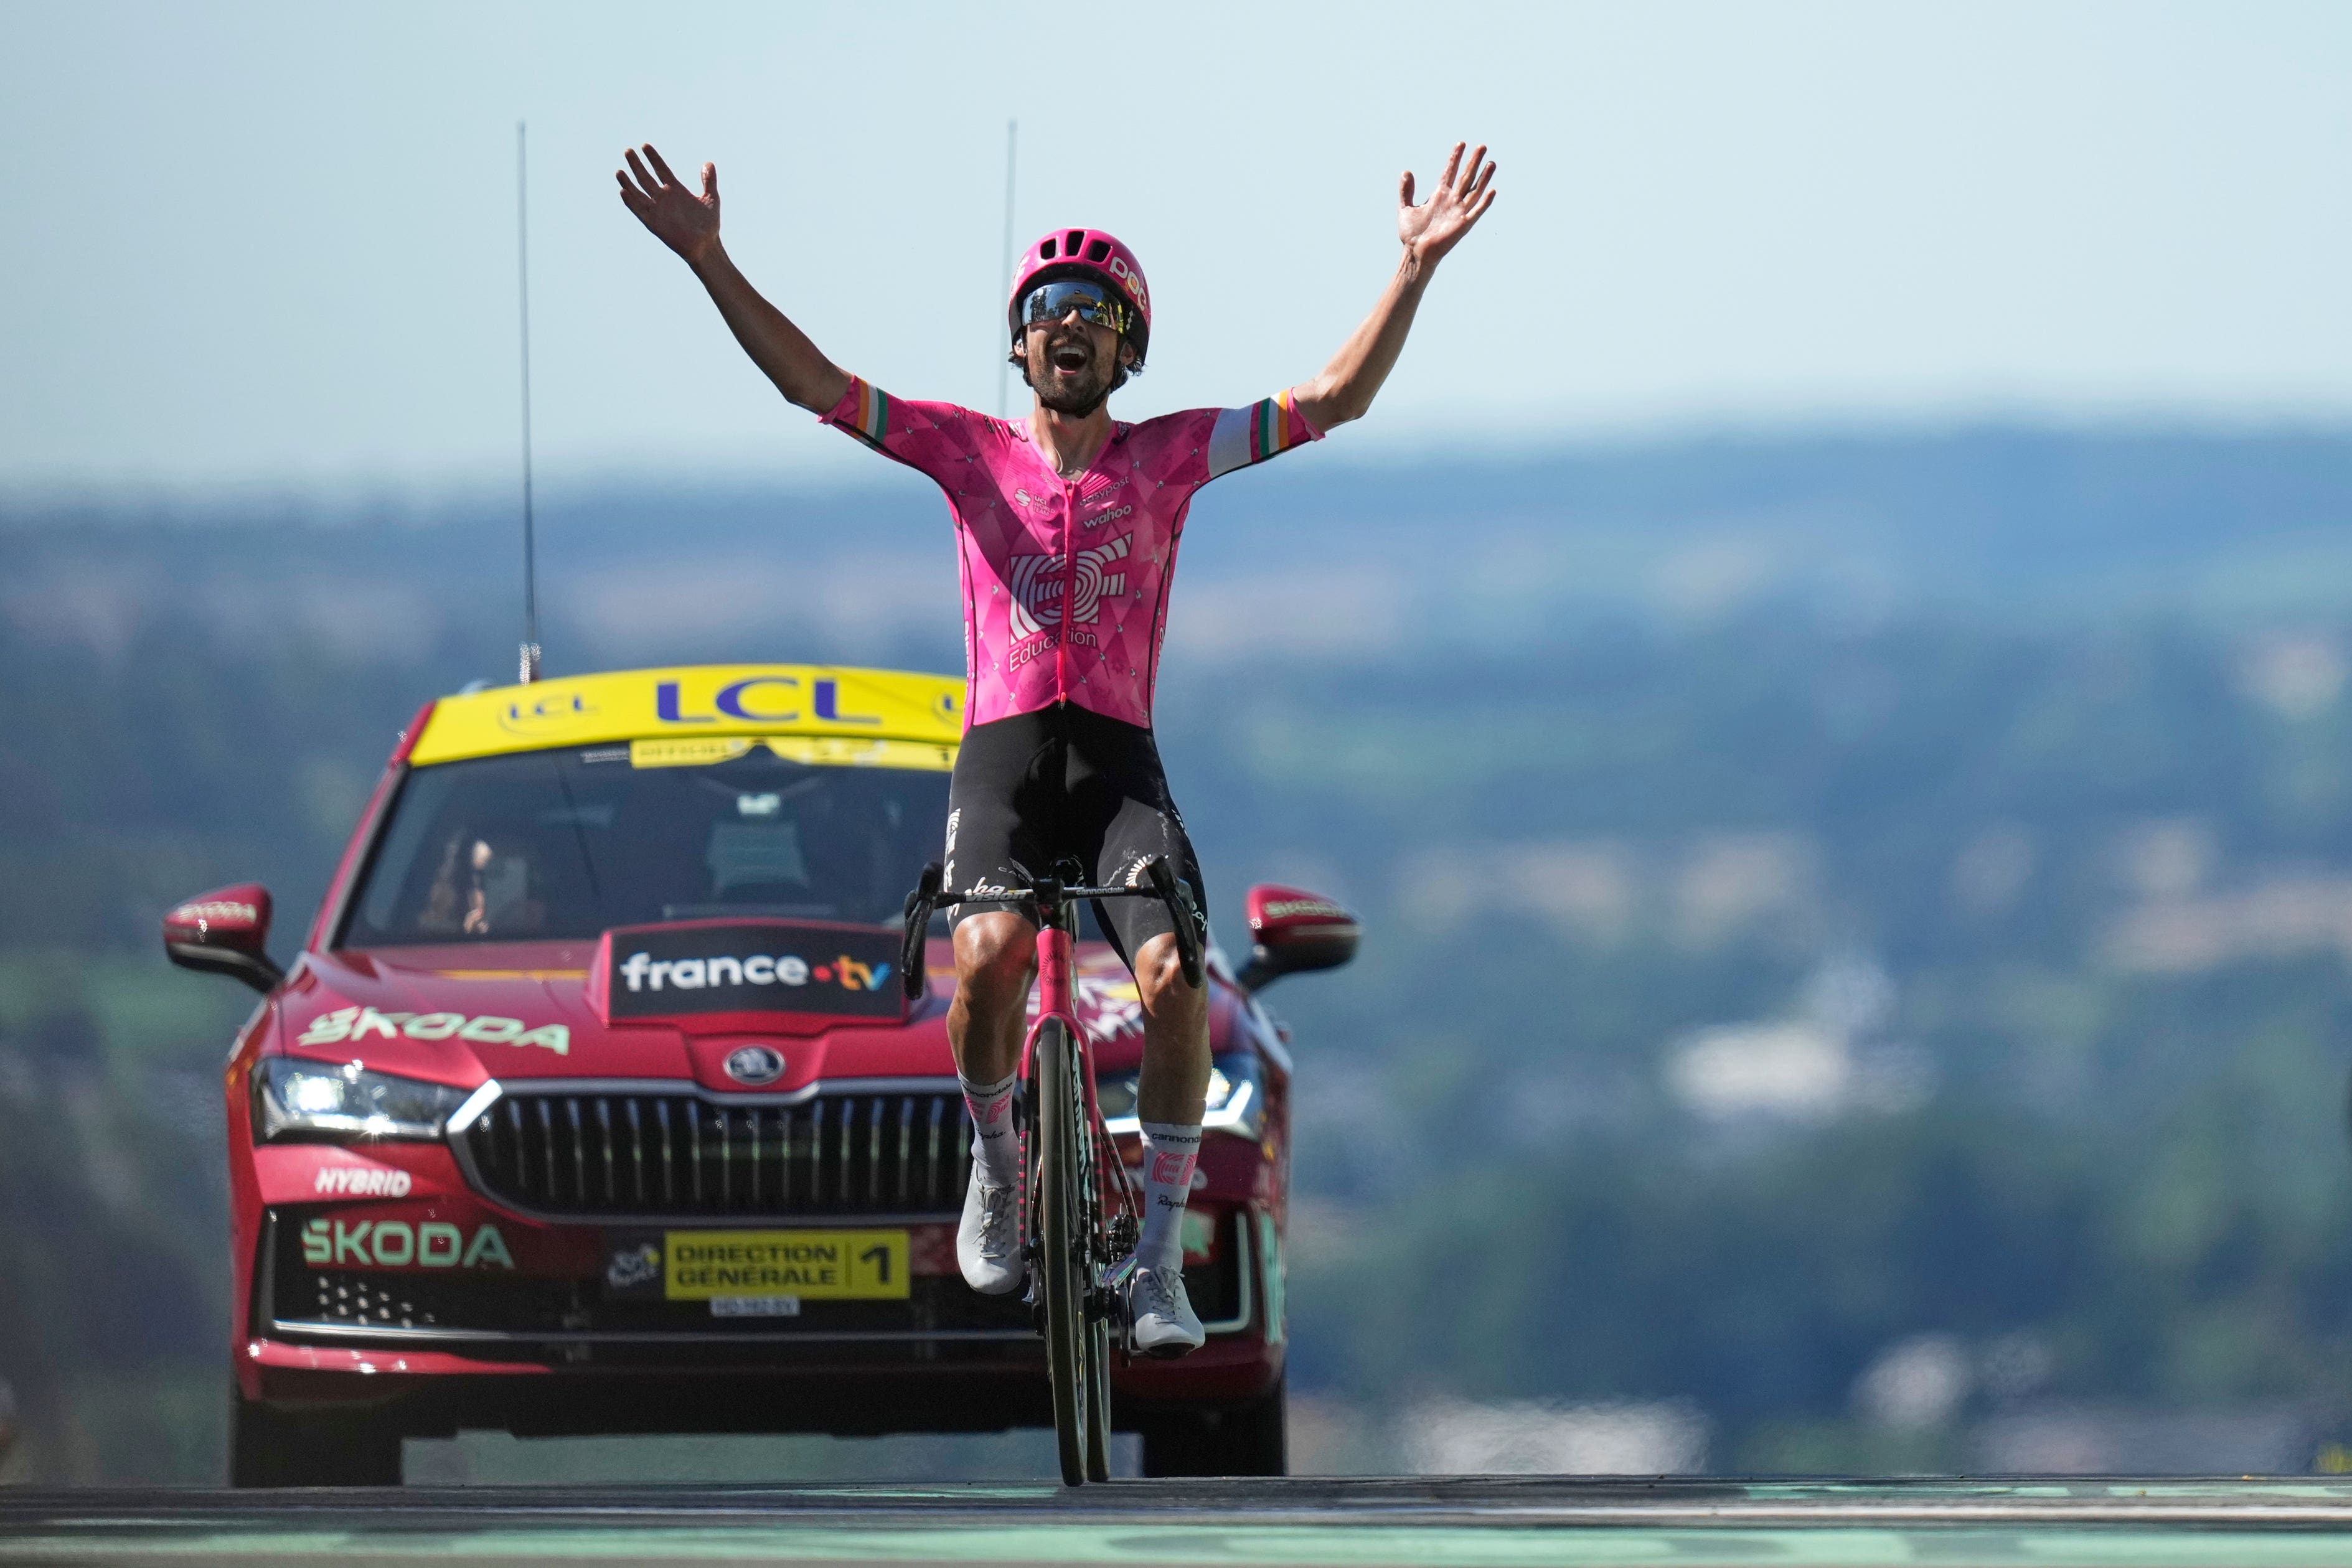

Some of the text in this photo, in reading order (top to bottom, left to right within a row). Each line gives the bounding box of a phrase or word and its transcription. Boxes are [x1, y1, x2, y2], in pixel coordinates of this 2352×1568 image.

[1034, 495, 1047, 505] UCI
[1079, 476, 1130, 506] easypost
[1083, 505, 1132, 528] wahoo
[1009, 628, 1097, 673] Education
[657, 677, 880, 724] LCL
[1076, 886, 1125, 896] cannondale
[315, 1167, 412, 1198] HYBRID
[675, 1244, 891, 1285] DIRECTION 1
